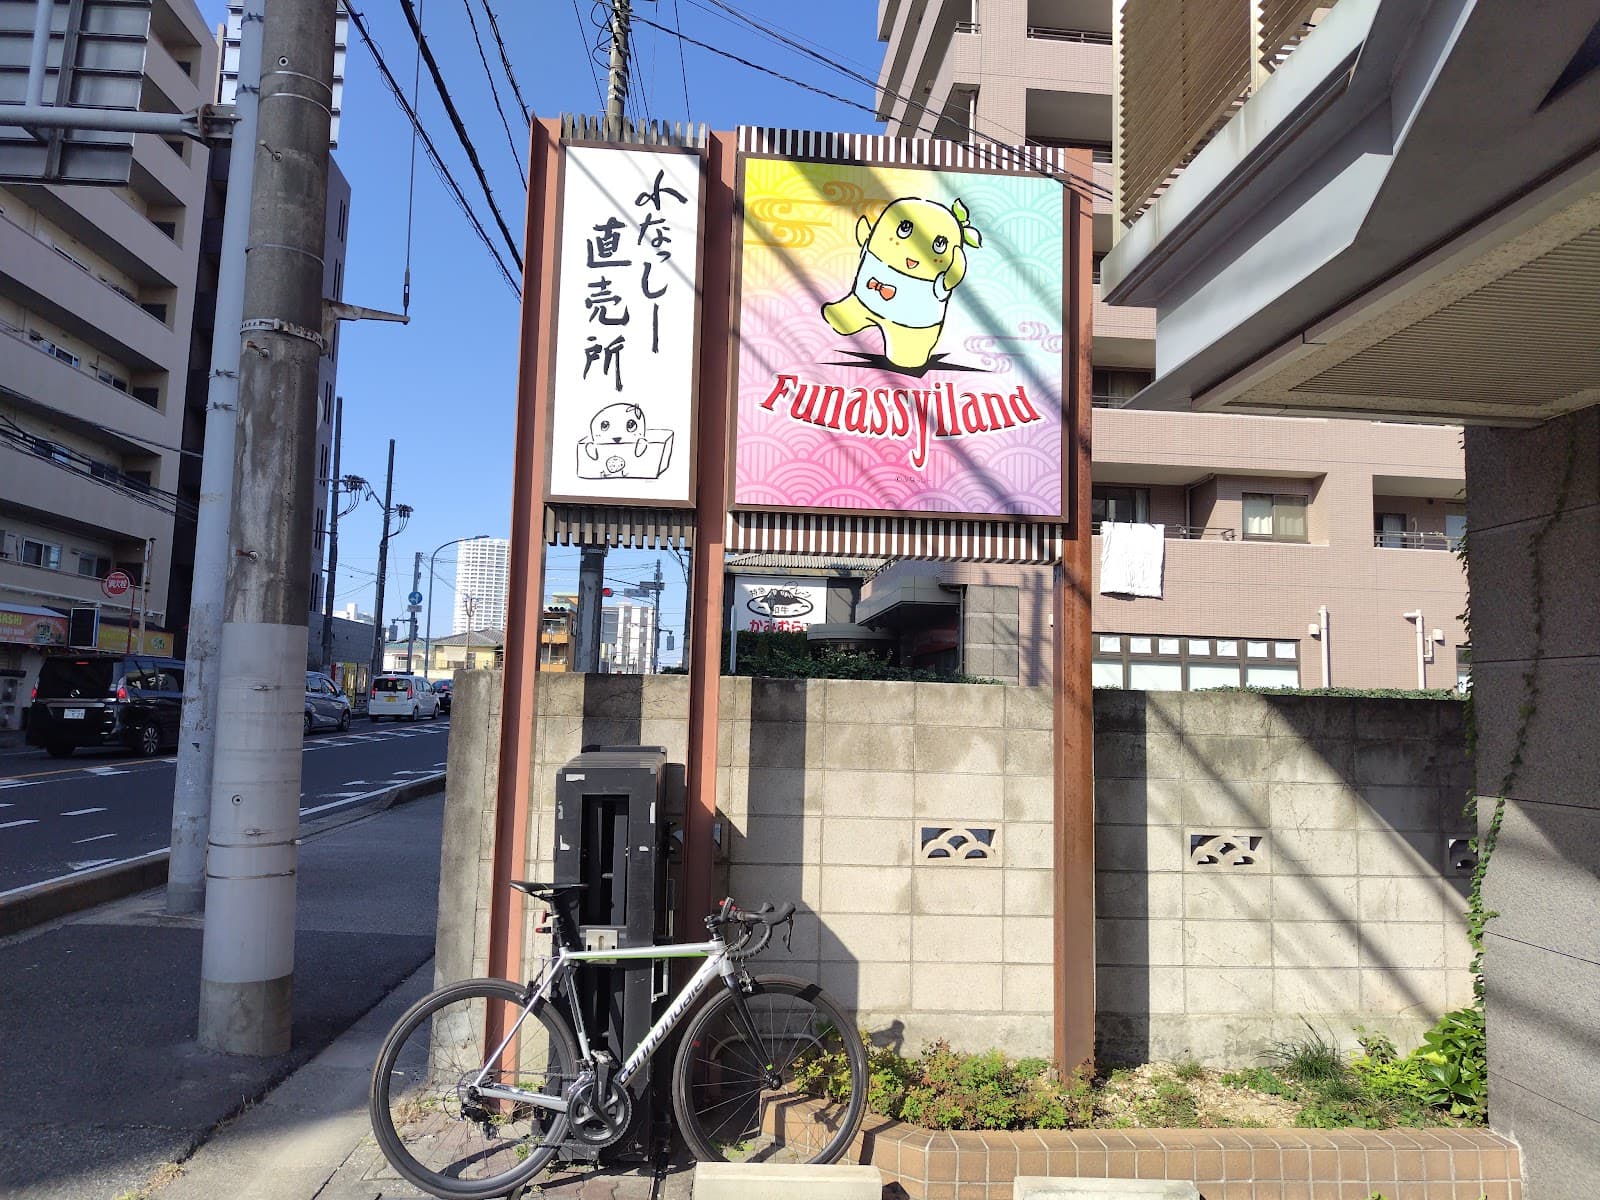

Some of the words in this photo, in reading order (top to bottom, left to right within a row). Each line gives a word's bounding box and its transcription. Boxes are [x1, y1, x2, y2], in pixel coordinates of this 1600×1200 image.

[582, 217, 632, 392] 直売所
[759, 374, 1042, 468] Funassyiland
